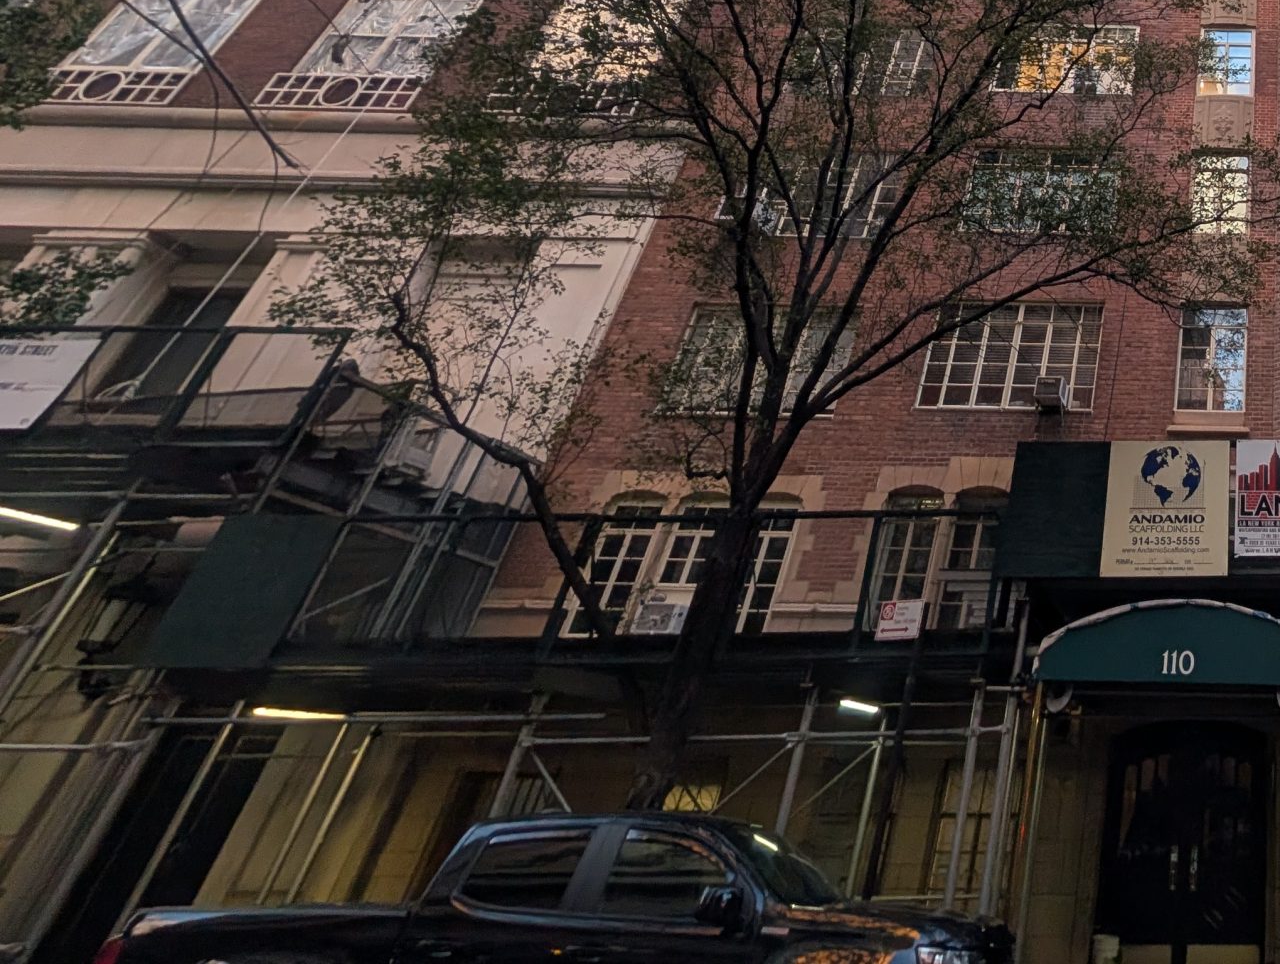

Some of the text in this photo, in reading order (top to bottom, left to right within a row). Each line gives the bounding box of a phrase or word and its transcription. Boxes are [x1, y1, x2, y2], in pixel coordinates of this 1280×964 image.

[20, 345, 59, 356] STREET
[1129, 514, 1205, 524] ANDAMIO
[1129, 524, 1205, 533] SCAFFOLDING LLC
[1132, 536, 1200, 546] 914-353-5555
[1162, 650, 1195, 675] 110
